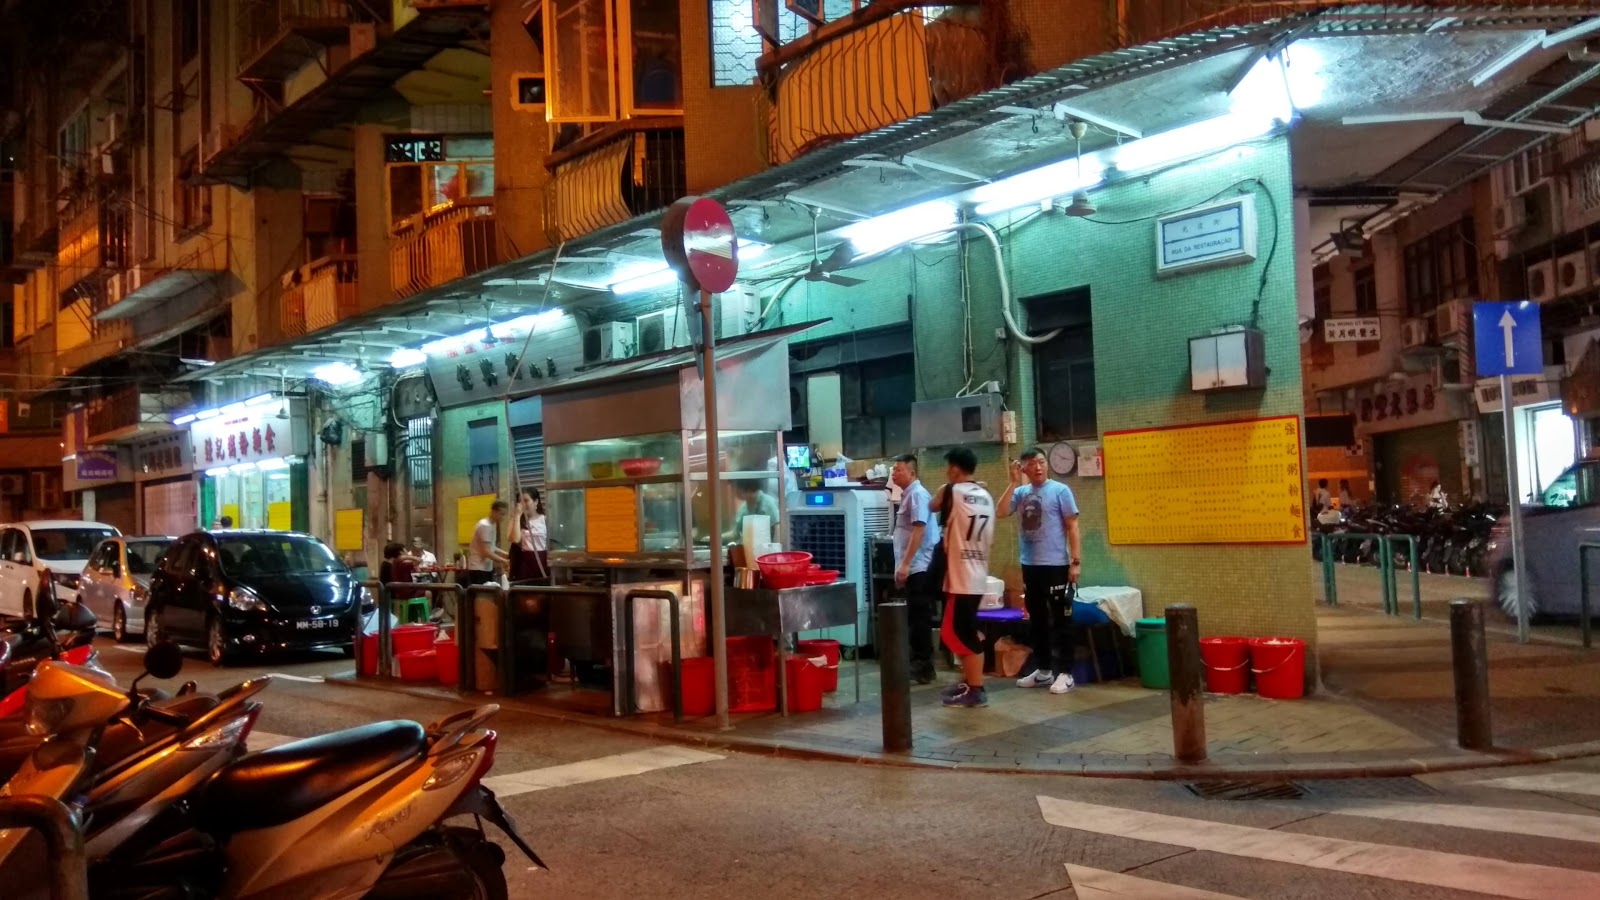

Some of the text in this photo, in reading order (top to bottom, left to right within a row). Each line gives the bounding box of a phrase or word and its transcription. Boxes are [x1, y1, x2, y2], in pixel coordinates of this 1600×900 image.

[1171, 248, 1183, 256] RUA
[1193, 237, 1233, 250] RESTAURAÇÃO
[964, 514, 991, 542] 17
